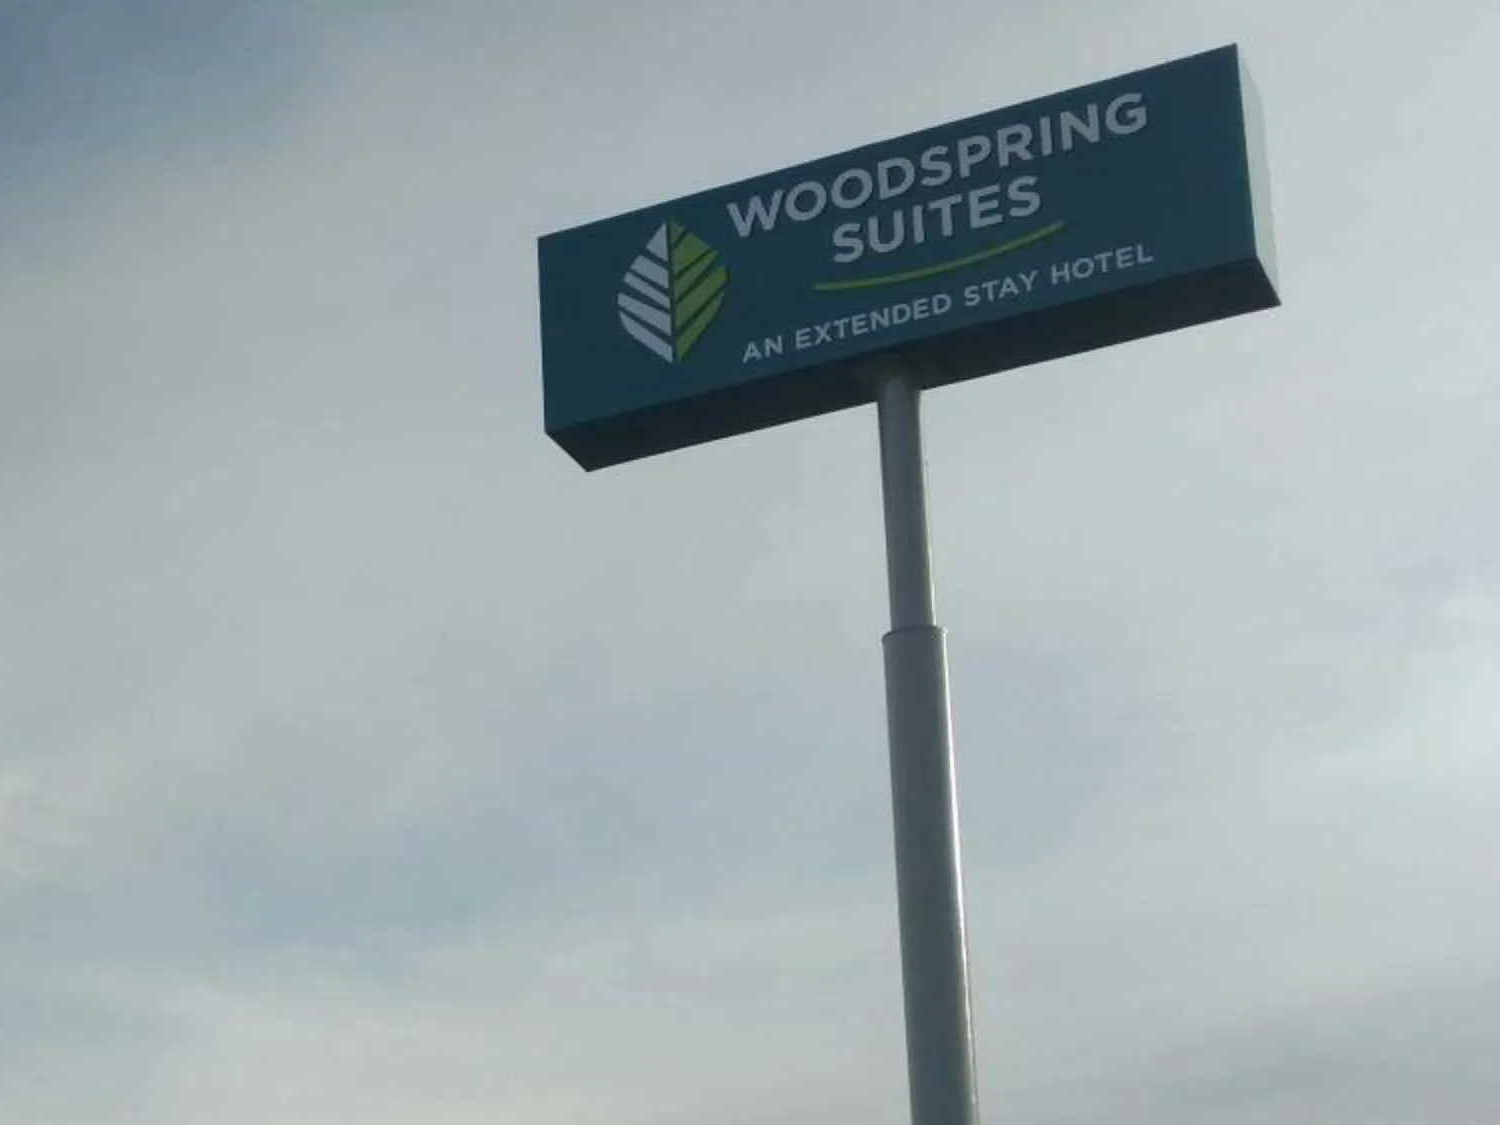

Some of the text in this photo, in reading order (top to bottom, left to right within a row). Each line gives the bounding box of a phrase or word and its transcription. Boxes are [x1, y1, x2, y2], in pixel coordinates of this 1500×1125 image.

[727, 92, 1148, 237] WOODSPRING
[831, 175, 1042, 264] SUITES
[742, 243, 1155, 363] AN EXTENDED STAY HOTEL
